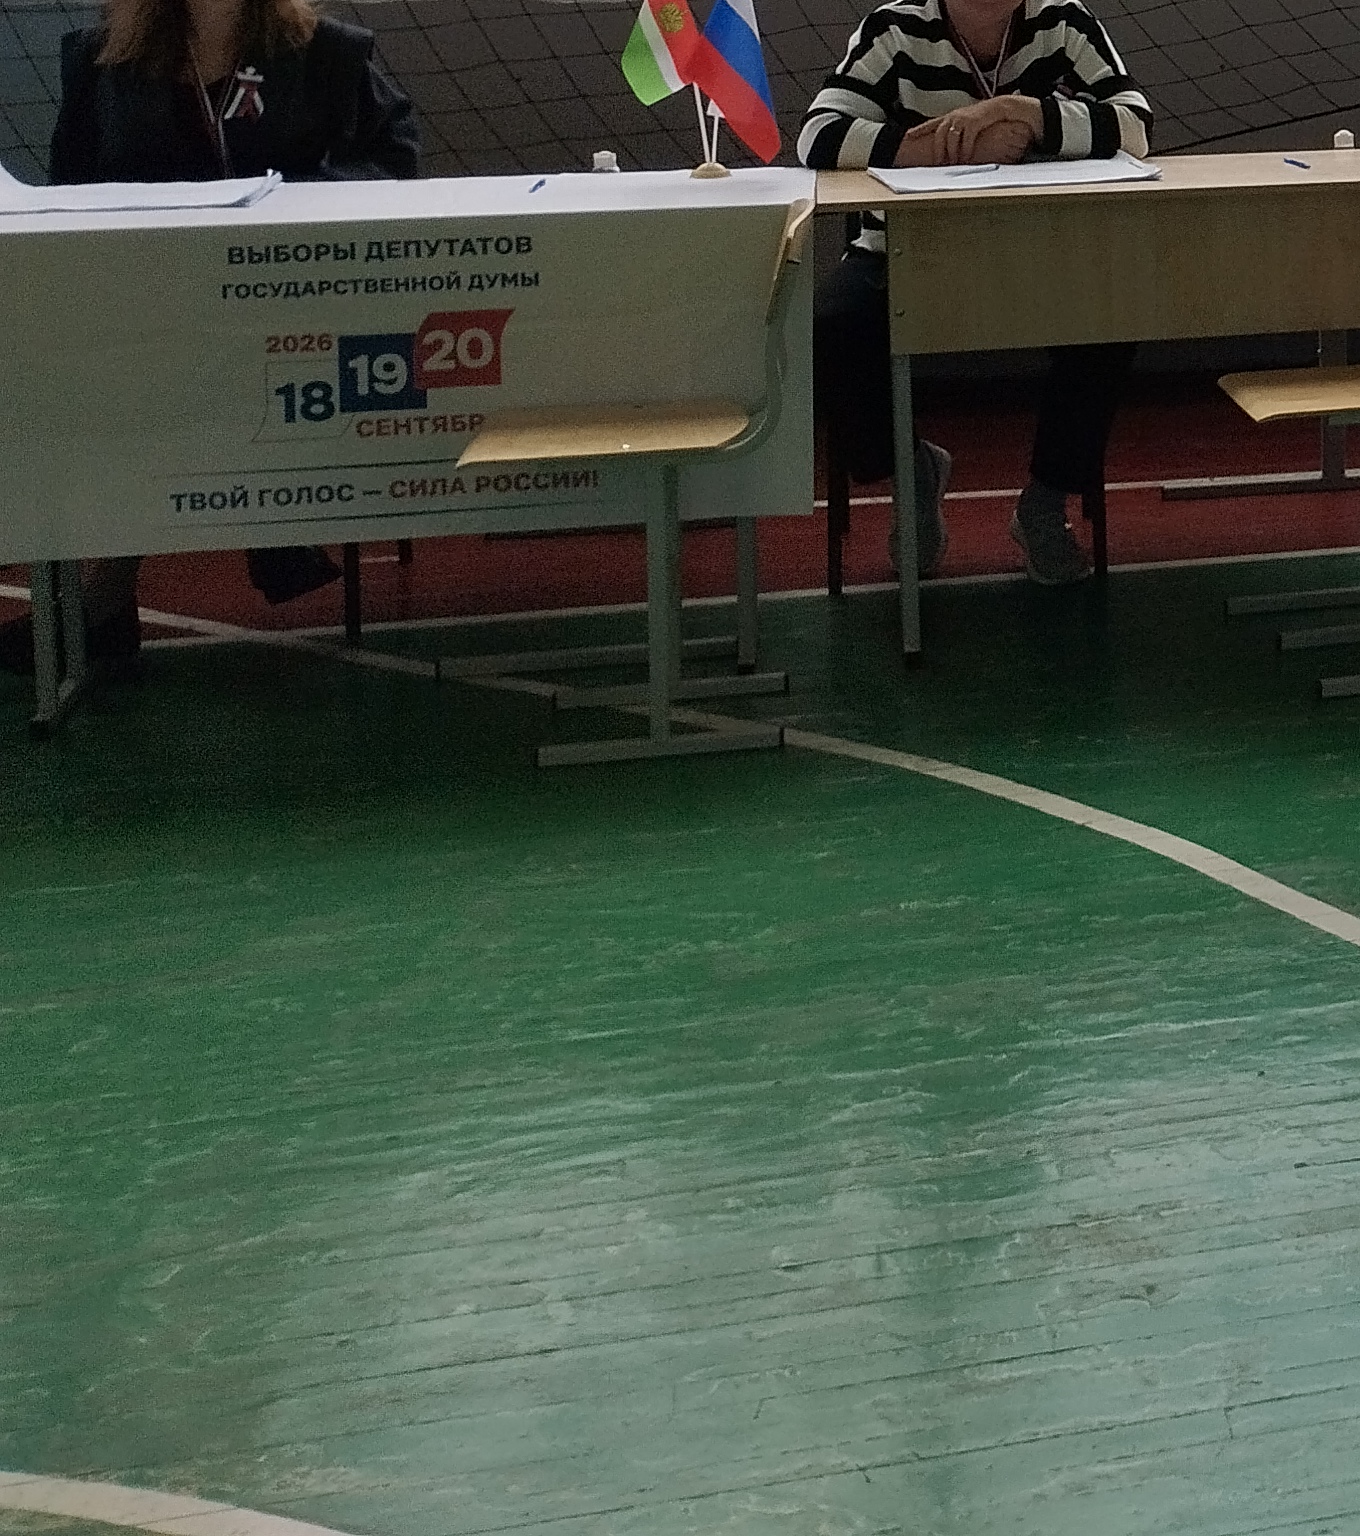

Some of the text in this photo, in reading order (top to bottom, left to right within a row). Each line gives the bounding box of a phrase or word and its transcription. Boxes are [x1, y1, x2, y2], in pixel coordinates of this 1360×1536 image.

[226, 235, 534, 265] ВЫБОРЫ ДЕПУТАТОВ
[221, 270, 541, 300] ГОСУДАРСТВЕННОЙ ДУМЫ
[264, 332, 334, 354] 2026
[421, 326, 496, 372] 20
[348, 352, 409, 397] 19
[274, 379, 337, 424] 18
[355, 412, 487, 439] СЕНТЯБР
[169, 482, 250, 514] ТВОЙ
[257, 482, 356, 508] ГОЛОС
[388, 476, 469, 500] СИЛА
[474, 468, 600, 494] РОССИИ!
